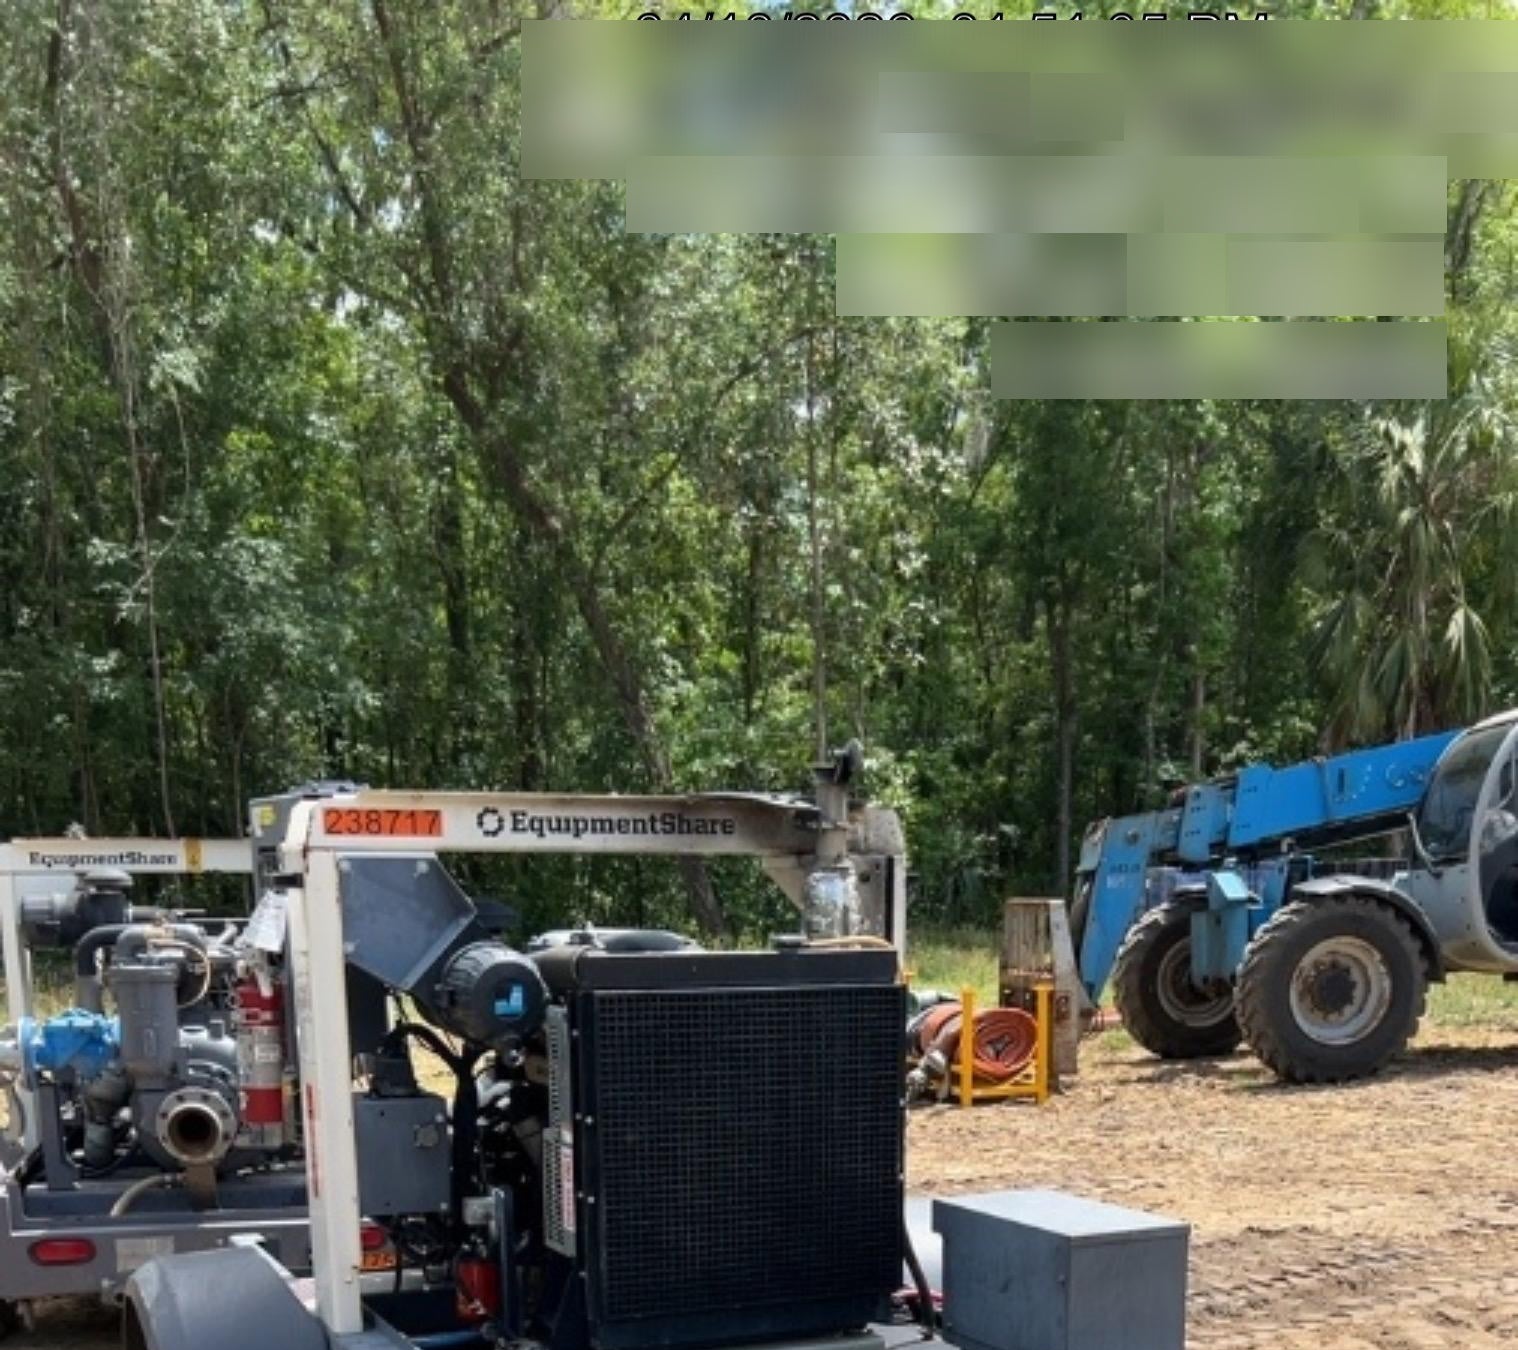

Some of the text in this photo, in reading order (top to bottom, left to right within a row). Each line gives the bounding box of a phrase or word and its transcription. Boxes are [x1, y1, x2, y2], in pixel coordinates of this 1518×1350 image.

[325, 809, 441, 835] 238717
[510, 809, 736, 838] EquipmentShare
[29, 851, 178, 868] EquipmentShare
